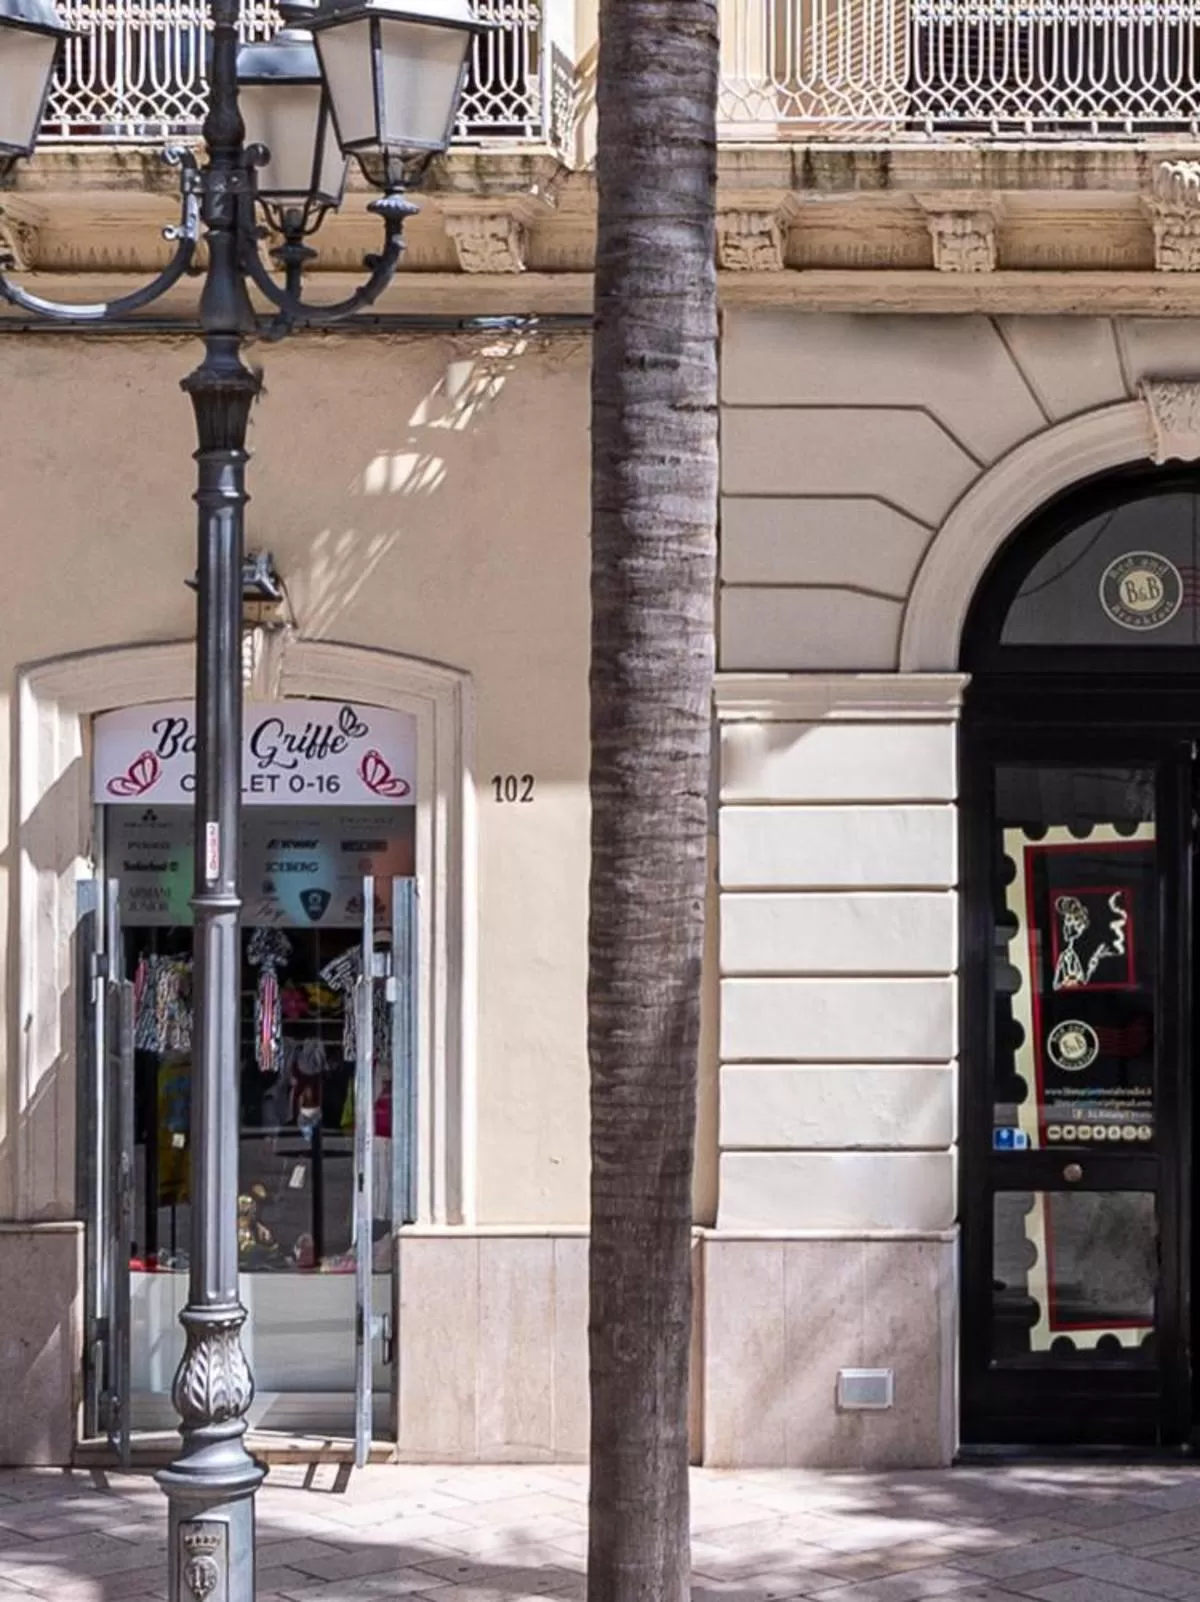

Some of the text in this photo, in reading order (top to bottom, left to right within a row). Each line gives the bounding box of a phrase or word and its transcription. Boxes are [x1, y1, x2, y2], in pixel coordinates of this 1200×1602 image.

[1124, 576, 1161, 605] B&B
[250, 717, 349, 769] Griffe
[180, 774, 279, 793] OET
[491, 774, 534, 803] 102
